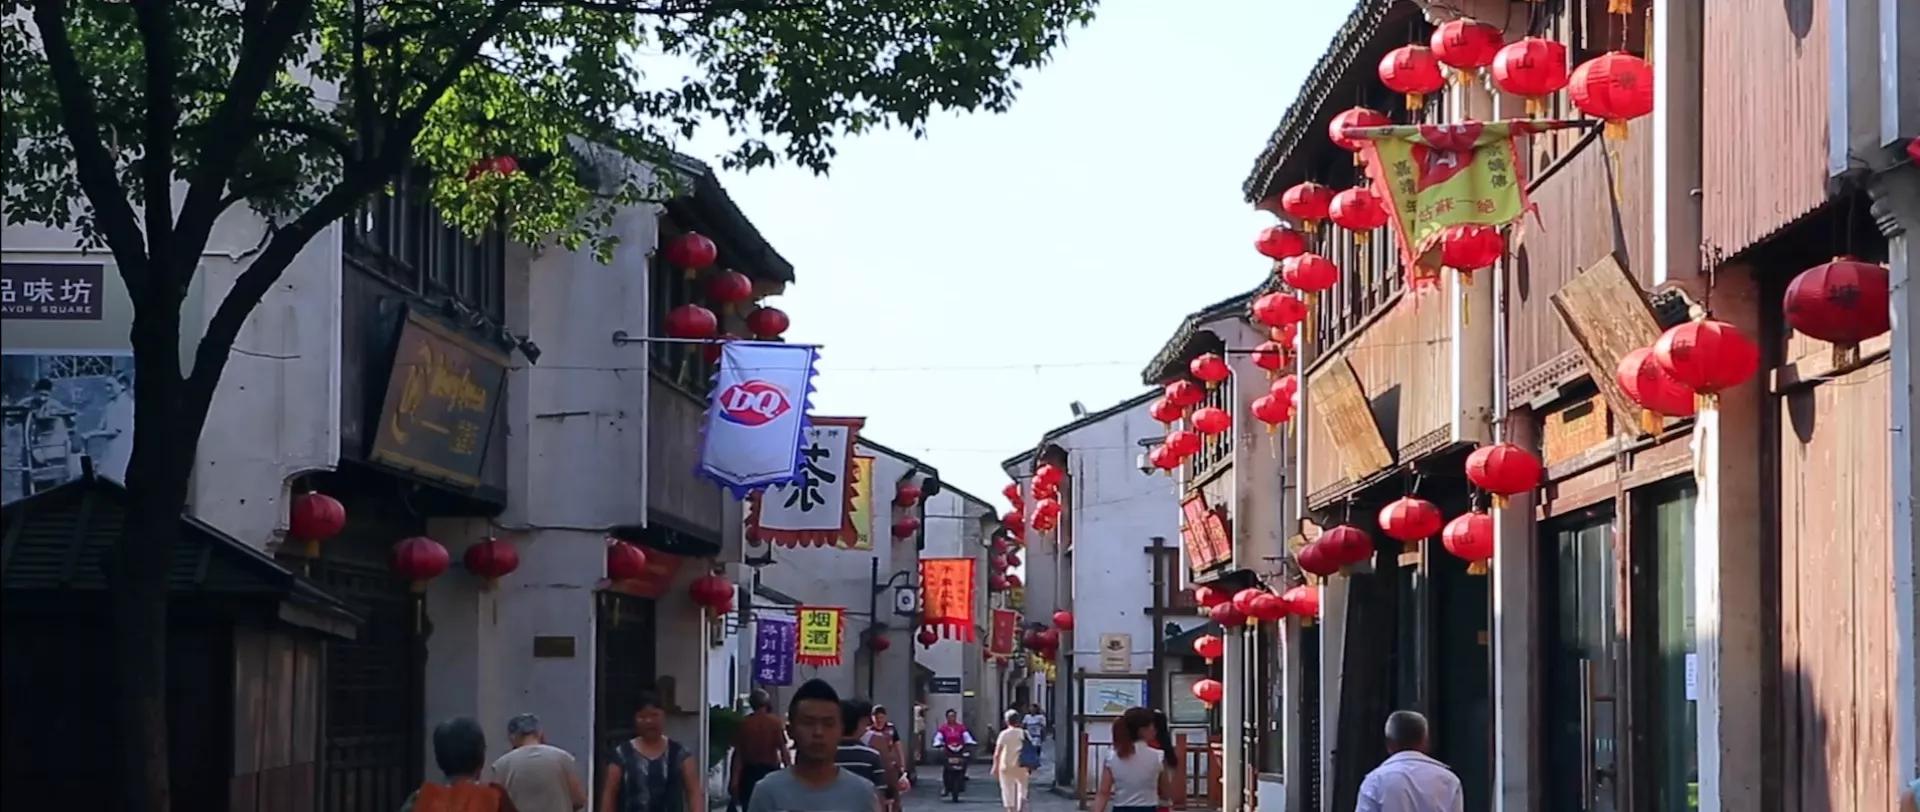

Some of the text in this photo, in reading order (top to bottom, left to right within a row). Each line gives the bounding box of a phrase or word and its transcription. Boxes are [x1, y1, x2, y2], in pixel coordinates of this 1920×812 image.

[1, 278, 93, 303] 品味坊
[727, 387, 781, 418] DQ
[784, 443, 836, 512] 茶
[806, 610, 831, 645] 烟酒
